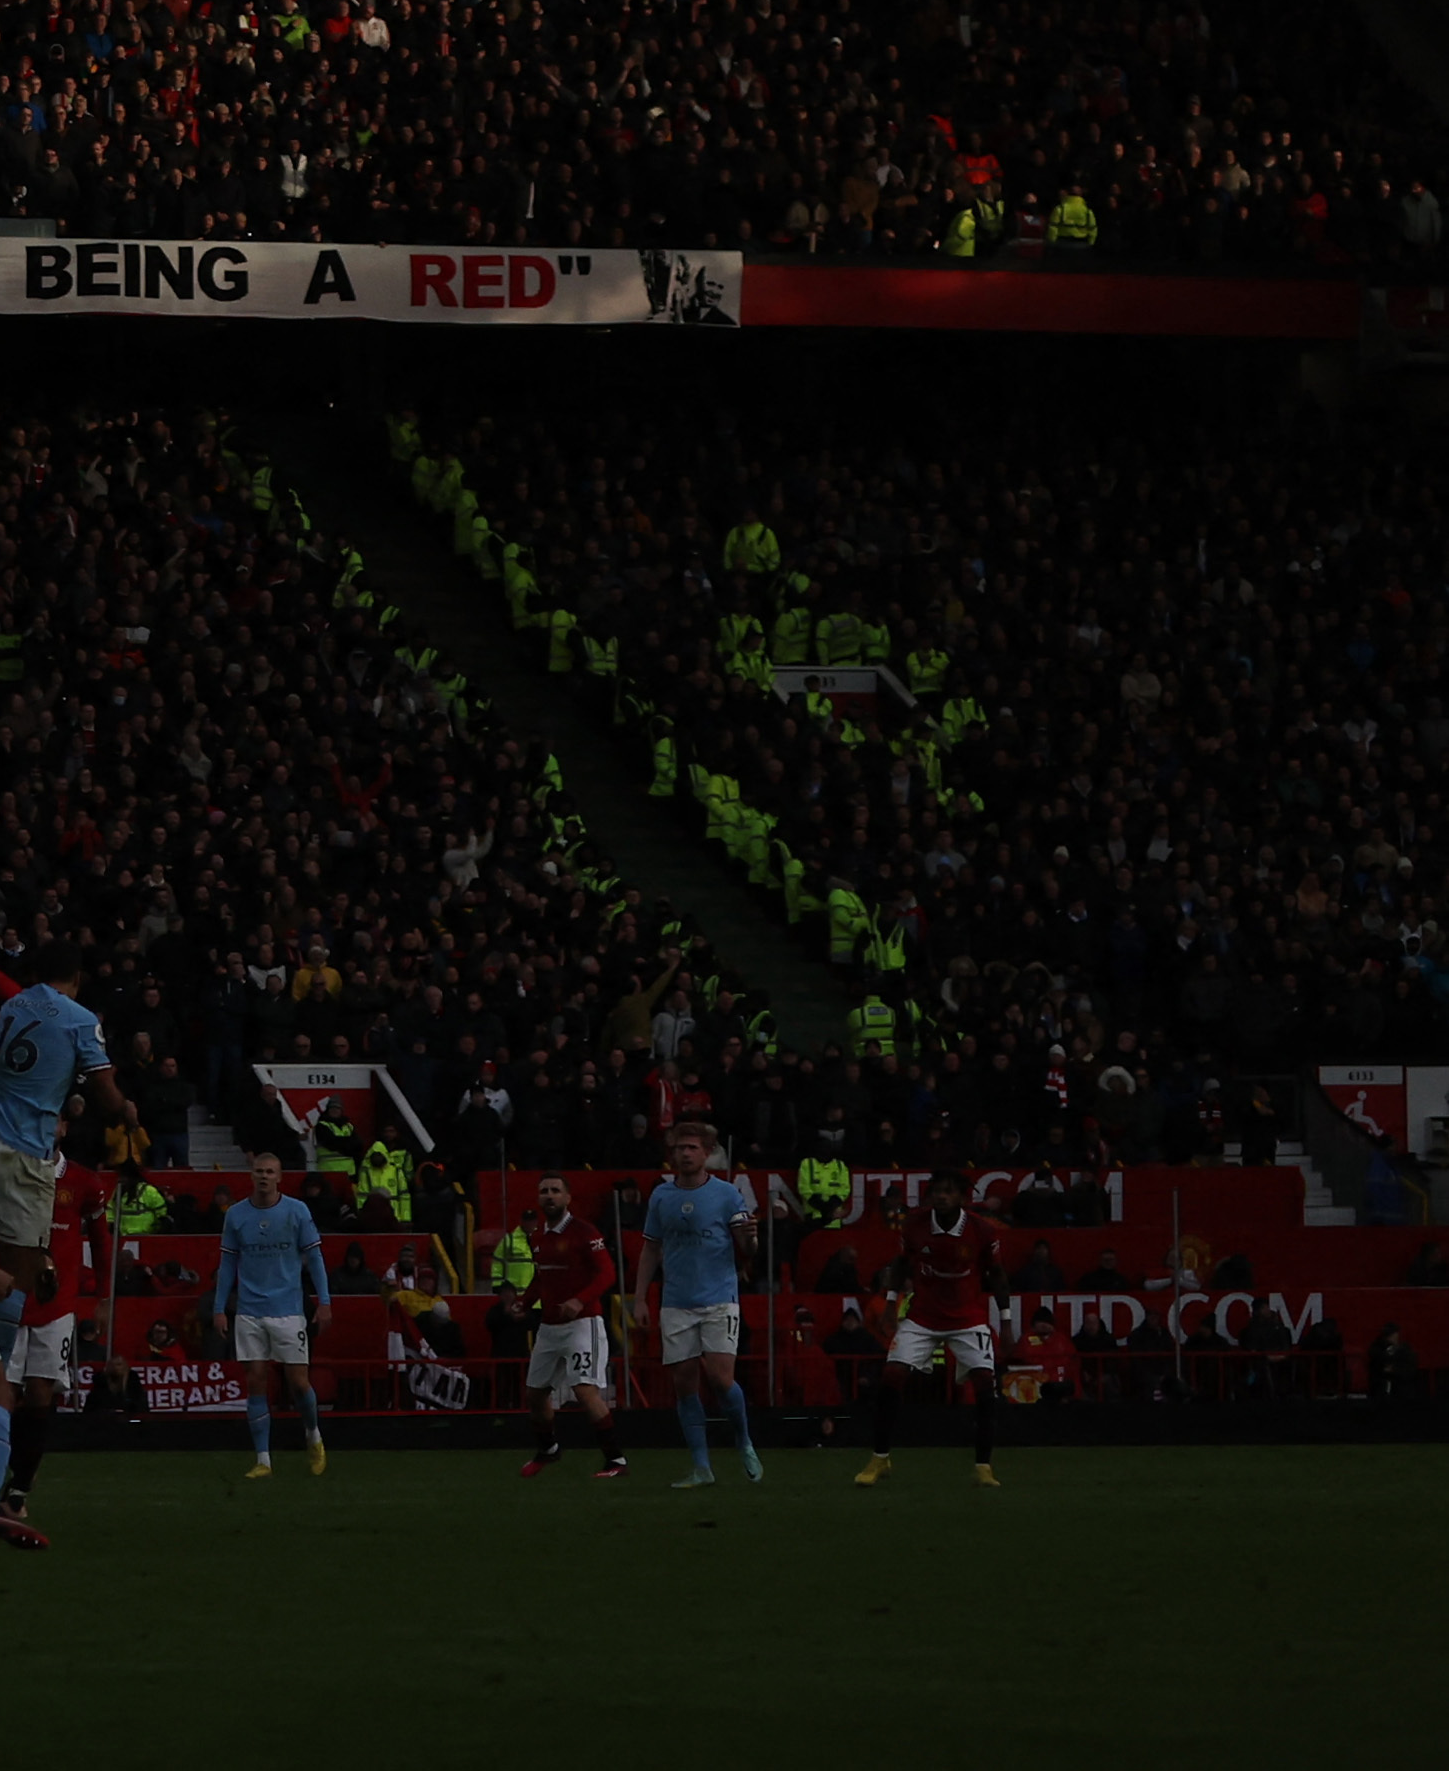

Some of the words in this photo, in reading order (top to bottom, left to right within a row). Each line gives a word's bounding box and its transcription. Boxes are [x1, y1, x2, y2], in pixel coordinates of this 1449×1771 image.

[26, 242, 248, 302] BEING
[303, 248, 356, 305] A
[409, 253, 592, 309] RED"
[307, 1074, 336, 1085] E134
[727, 1315, 738, 1336] 17
[60, 1337, 70, 1360] 8
[297, 1331, 306, 1349] 9
[976, 1331, 991, 1351] 17
[206, 1361, 226, 1381] &
[572, 1352, 592, 1371] 23
[146, 1379, 242, 1408] IERAN'S
